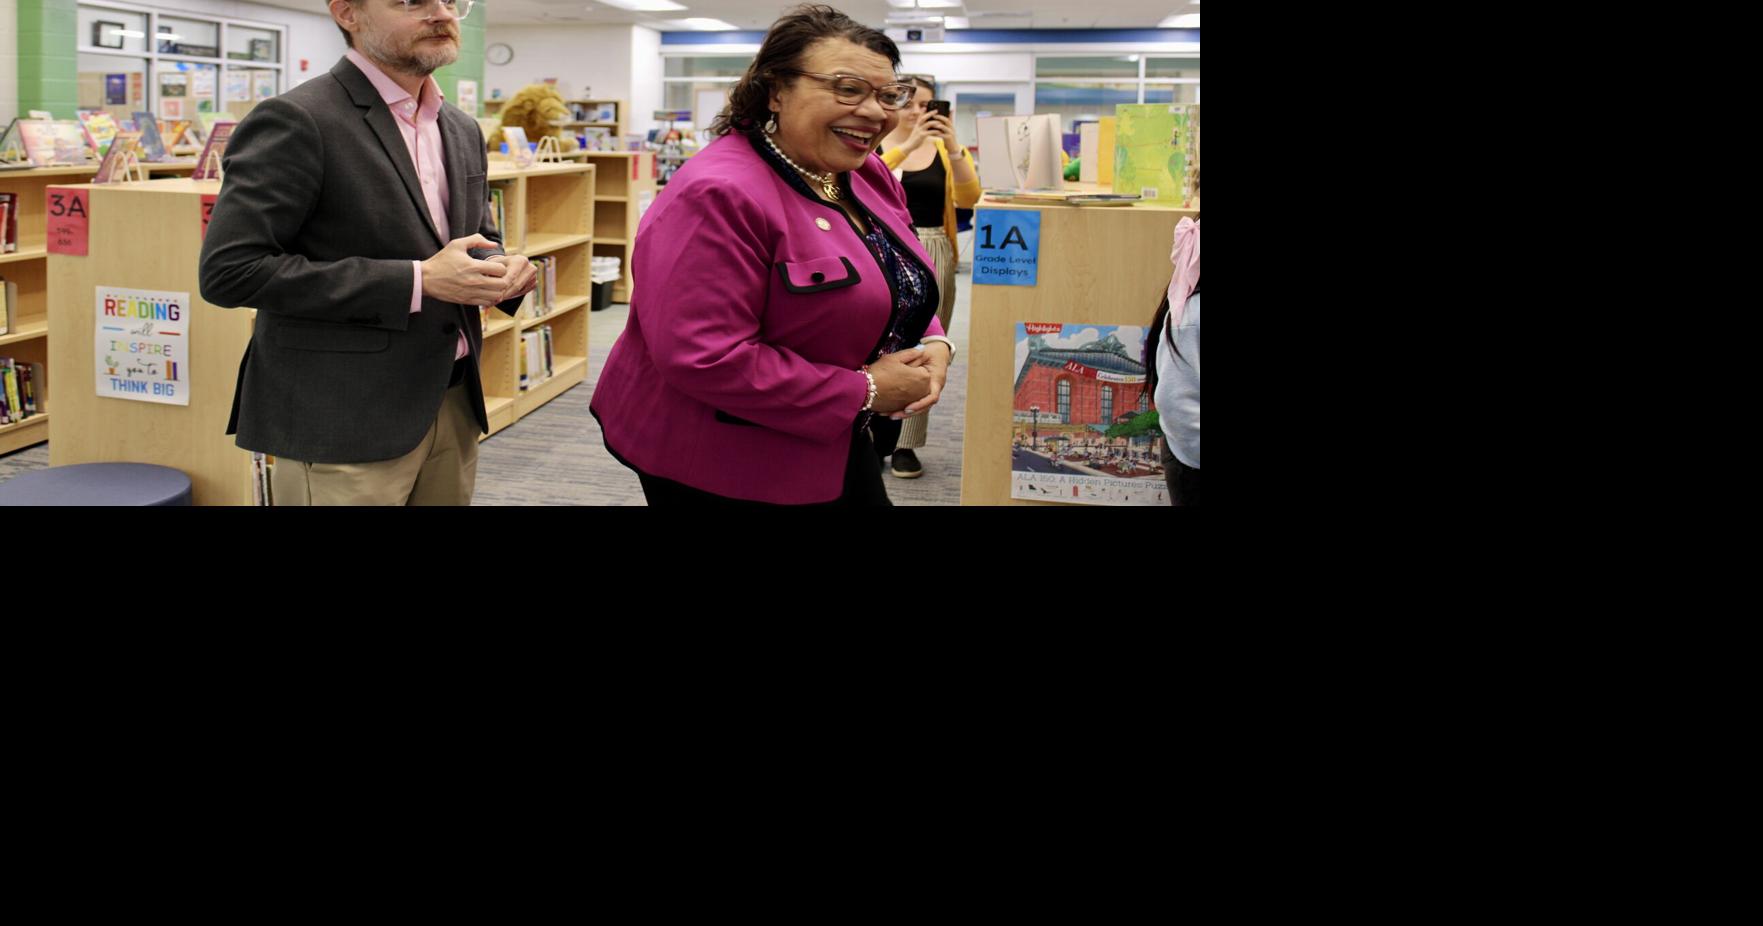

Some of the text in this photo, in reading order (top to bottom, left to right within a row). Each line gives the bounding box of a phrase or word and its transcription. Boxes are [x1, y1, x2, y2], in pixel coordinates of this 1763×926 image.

[50, 194, 87, 218] 3A
[980, 224, 1029, 251] 1A
[975, 255, 1036, 264] Grade Level
[981, 266, 1029, 277] Displays
[104, 298, 180, 321] READING
[130, 322, 154, 337] will
[110, 340, 172, 357] INSPIRE
[127, 367, 144, 377] you
[1064, 362, 1085, 374] ALA
[110, 377, 175, 397] THINK BIG
[1017, 473, 1037, 481] ALA
[1059, 475, 1066, 483] A
[1069, 475, 1101, 486] Hidden
[1104, 478, 1144, 488] Pictures
